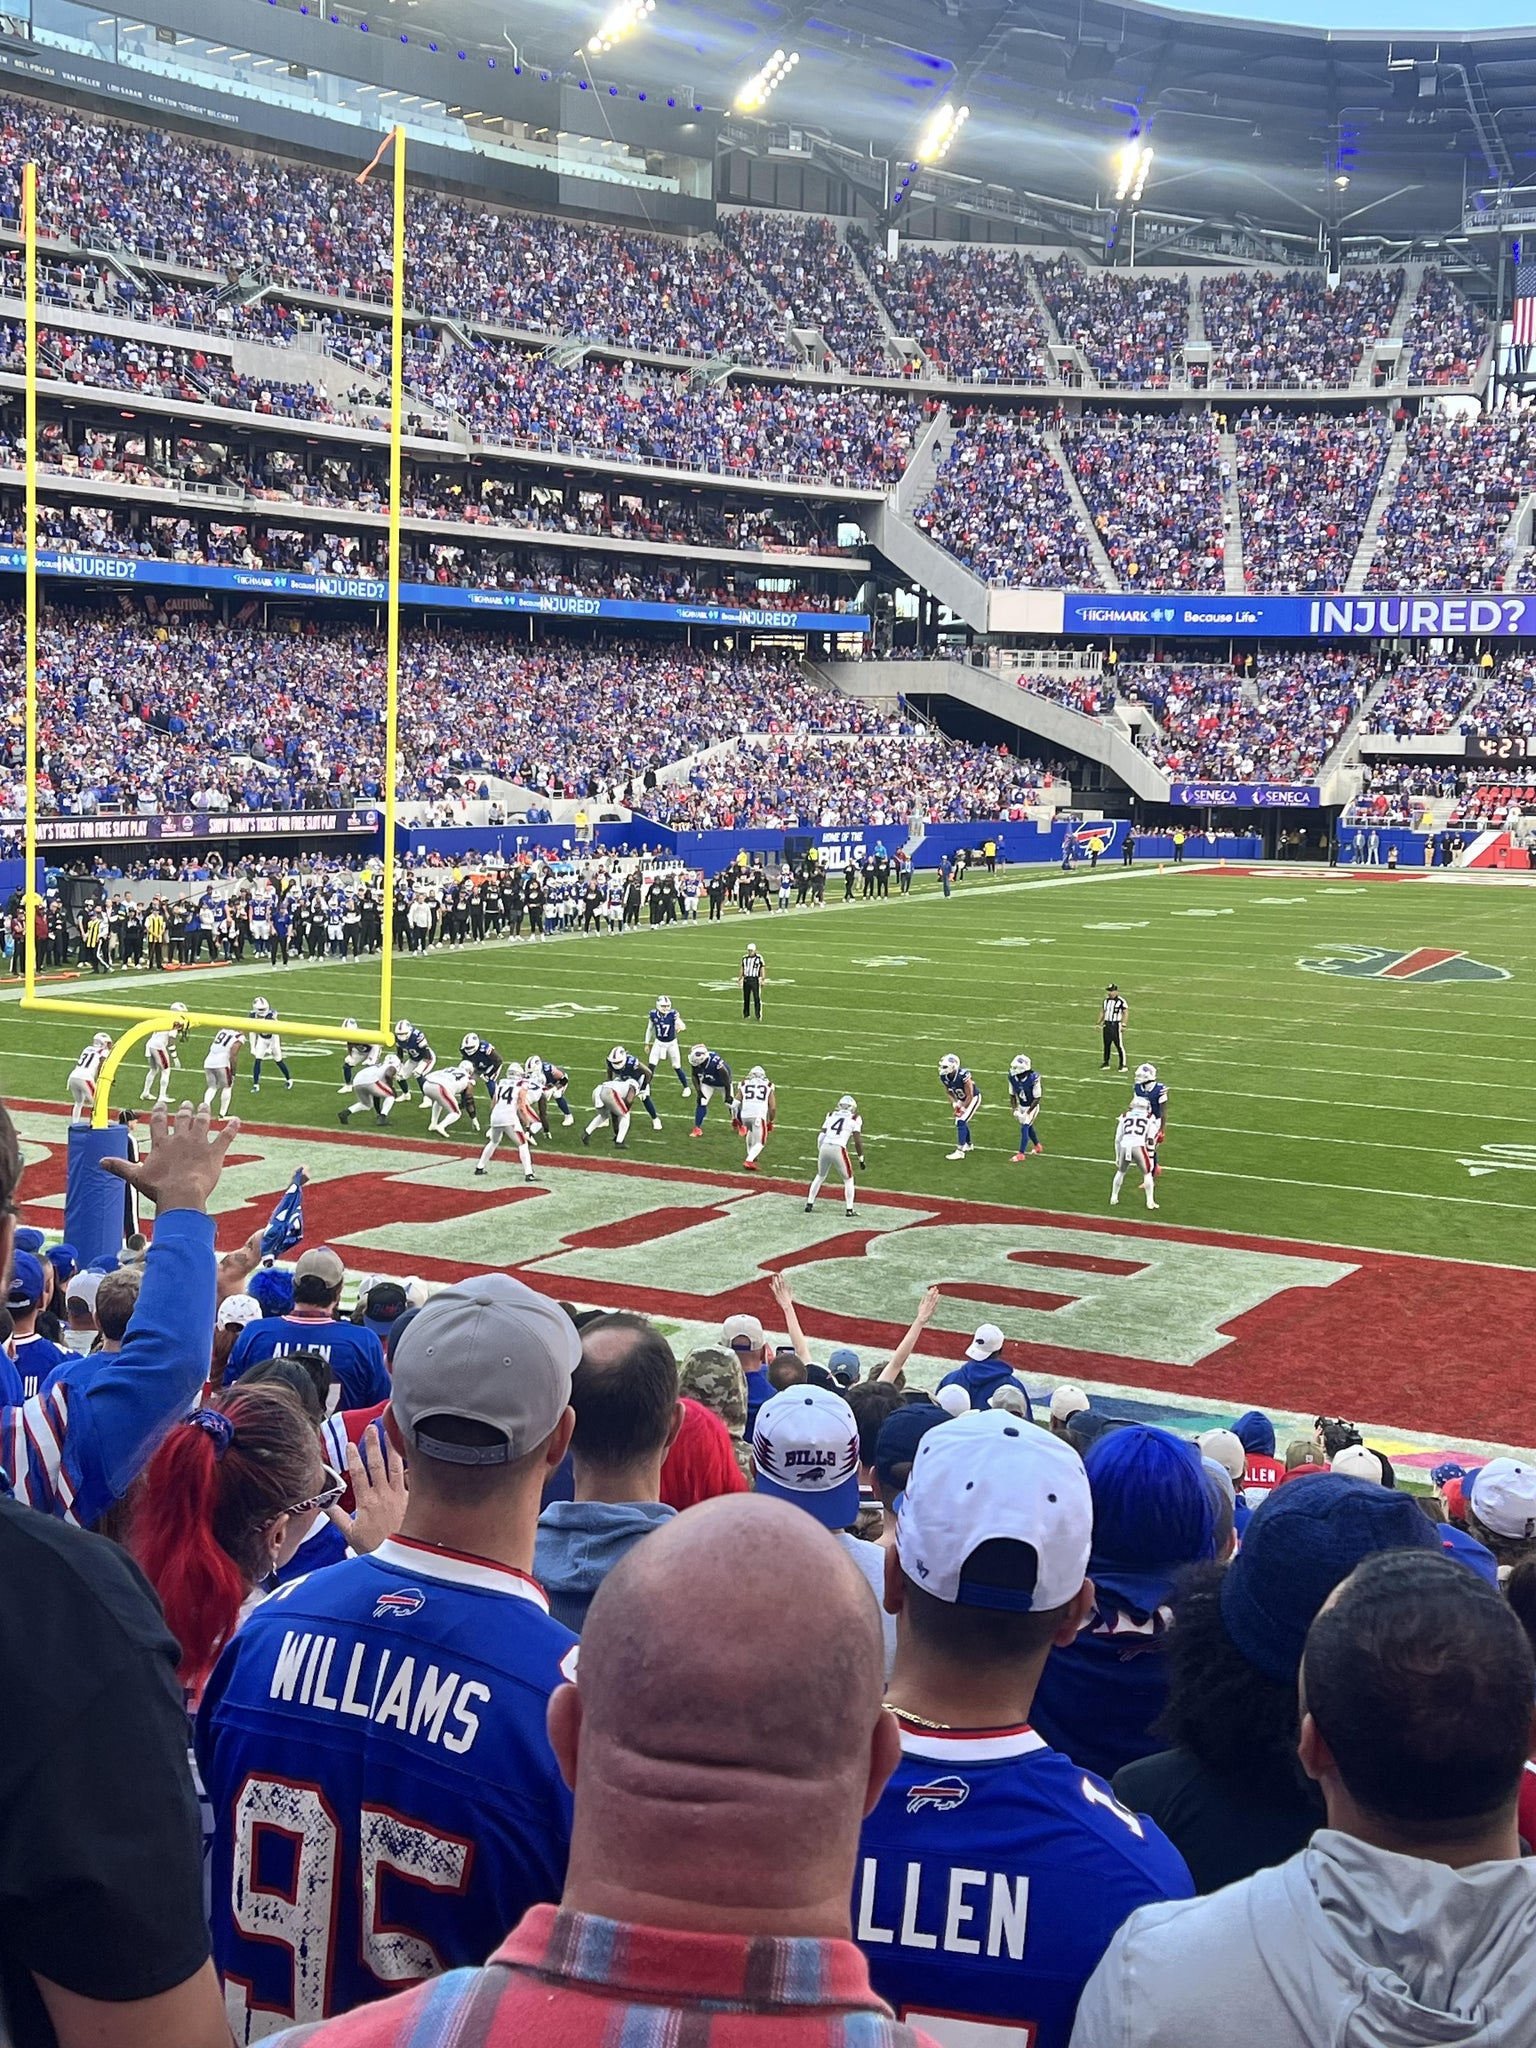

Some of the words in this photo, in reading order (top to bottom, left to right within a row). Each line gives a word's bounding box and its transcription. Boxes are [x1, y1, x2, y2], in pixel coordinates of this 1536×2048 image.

[57, 555, 137, 578] INJURED?
[315, 578, 385, 599] INJURED?
[540, 596, 600, 614] INJURED?
[739, 610, 798, 627] INJURED?
[1081, 609, 1150, 622] HIGHMARK
[1184, 610, 1233, 623] Because
[1310, 600, 1526, 633] INJURED?
[1479, 738, 1525, 759] 4:27
[1194, 789, 1238, 801] SENECA
[1265, 791, 1311, 802] SENECA
[54, 822, 80, 839] TICKET
[80, 822, 94, 838] FOR
[95, 821, 112, 838] FREE
[130, 820, 148, 837] PLAY
[822, 832, 841, 843] HOME
[841, 831, 850, 842] OF
[851, 831, 864, 842] THE
[818, 845, 867, 870] BILLS
[254, 906, 266, 916] 85
[215, 1031, 233, 1047] 91
[656, 1024, 671, 1038] 17
[77, 1052, 95, 1068] 31
[497, 1085, 514, 1105] 14
[744, 1084, 768, 1101] 53
[1019, 1089, 1027, 1102] 4
[830, 1117, 845, 1135] 4
[1123, 1118, 1148, 1136] 25
[784, 1450, 836, 1467] BILLS
[1244, 1467, 1276, 1483] LLEN
[269, 1630, 492, 1755] WILLIAMS
[224, 1771, 476, 2047] 95
[857, 1857, 1029, 1960] LLEN
